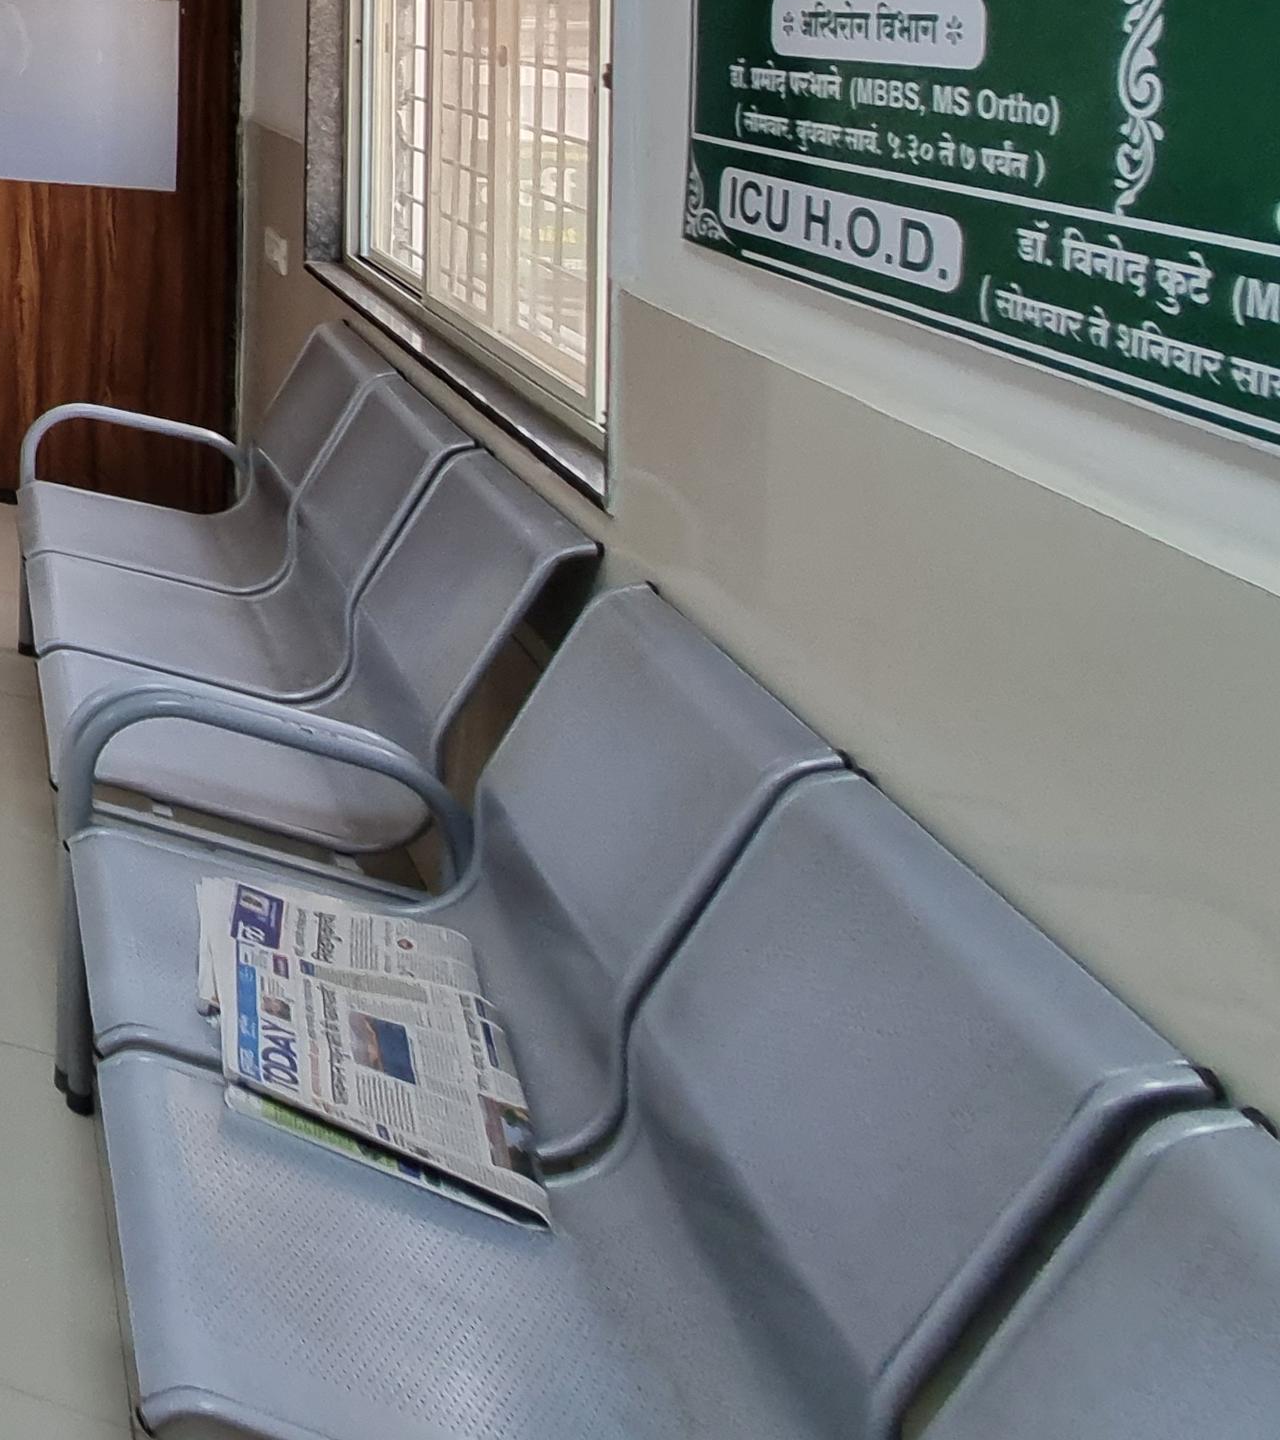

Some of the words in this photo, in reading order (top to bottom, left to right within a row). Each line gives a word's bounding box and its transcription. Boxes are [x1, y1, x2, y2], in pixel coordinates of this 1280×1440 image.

[876, 3, 938, 45] विभाग
[850, 80, 926, 117] (MBBS,
[933, 85, 971, 117] MS
[977, 89, 1060, 136] Ortho)
[730, 176, 790, 233] ICU
[804, 194, 949, 280] H.O.D.
[1017, 220, 1054, 266] डॉ.
[1062, 227, 1149, 297] विनोद
[994, 283, 1085, 342] सोमवार
[1088, 306, 1109, 348] ते
[1115, 321, 1224, 385] शनिवार
[261, 1018, 299, 1093] TODAY
